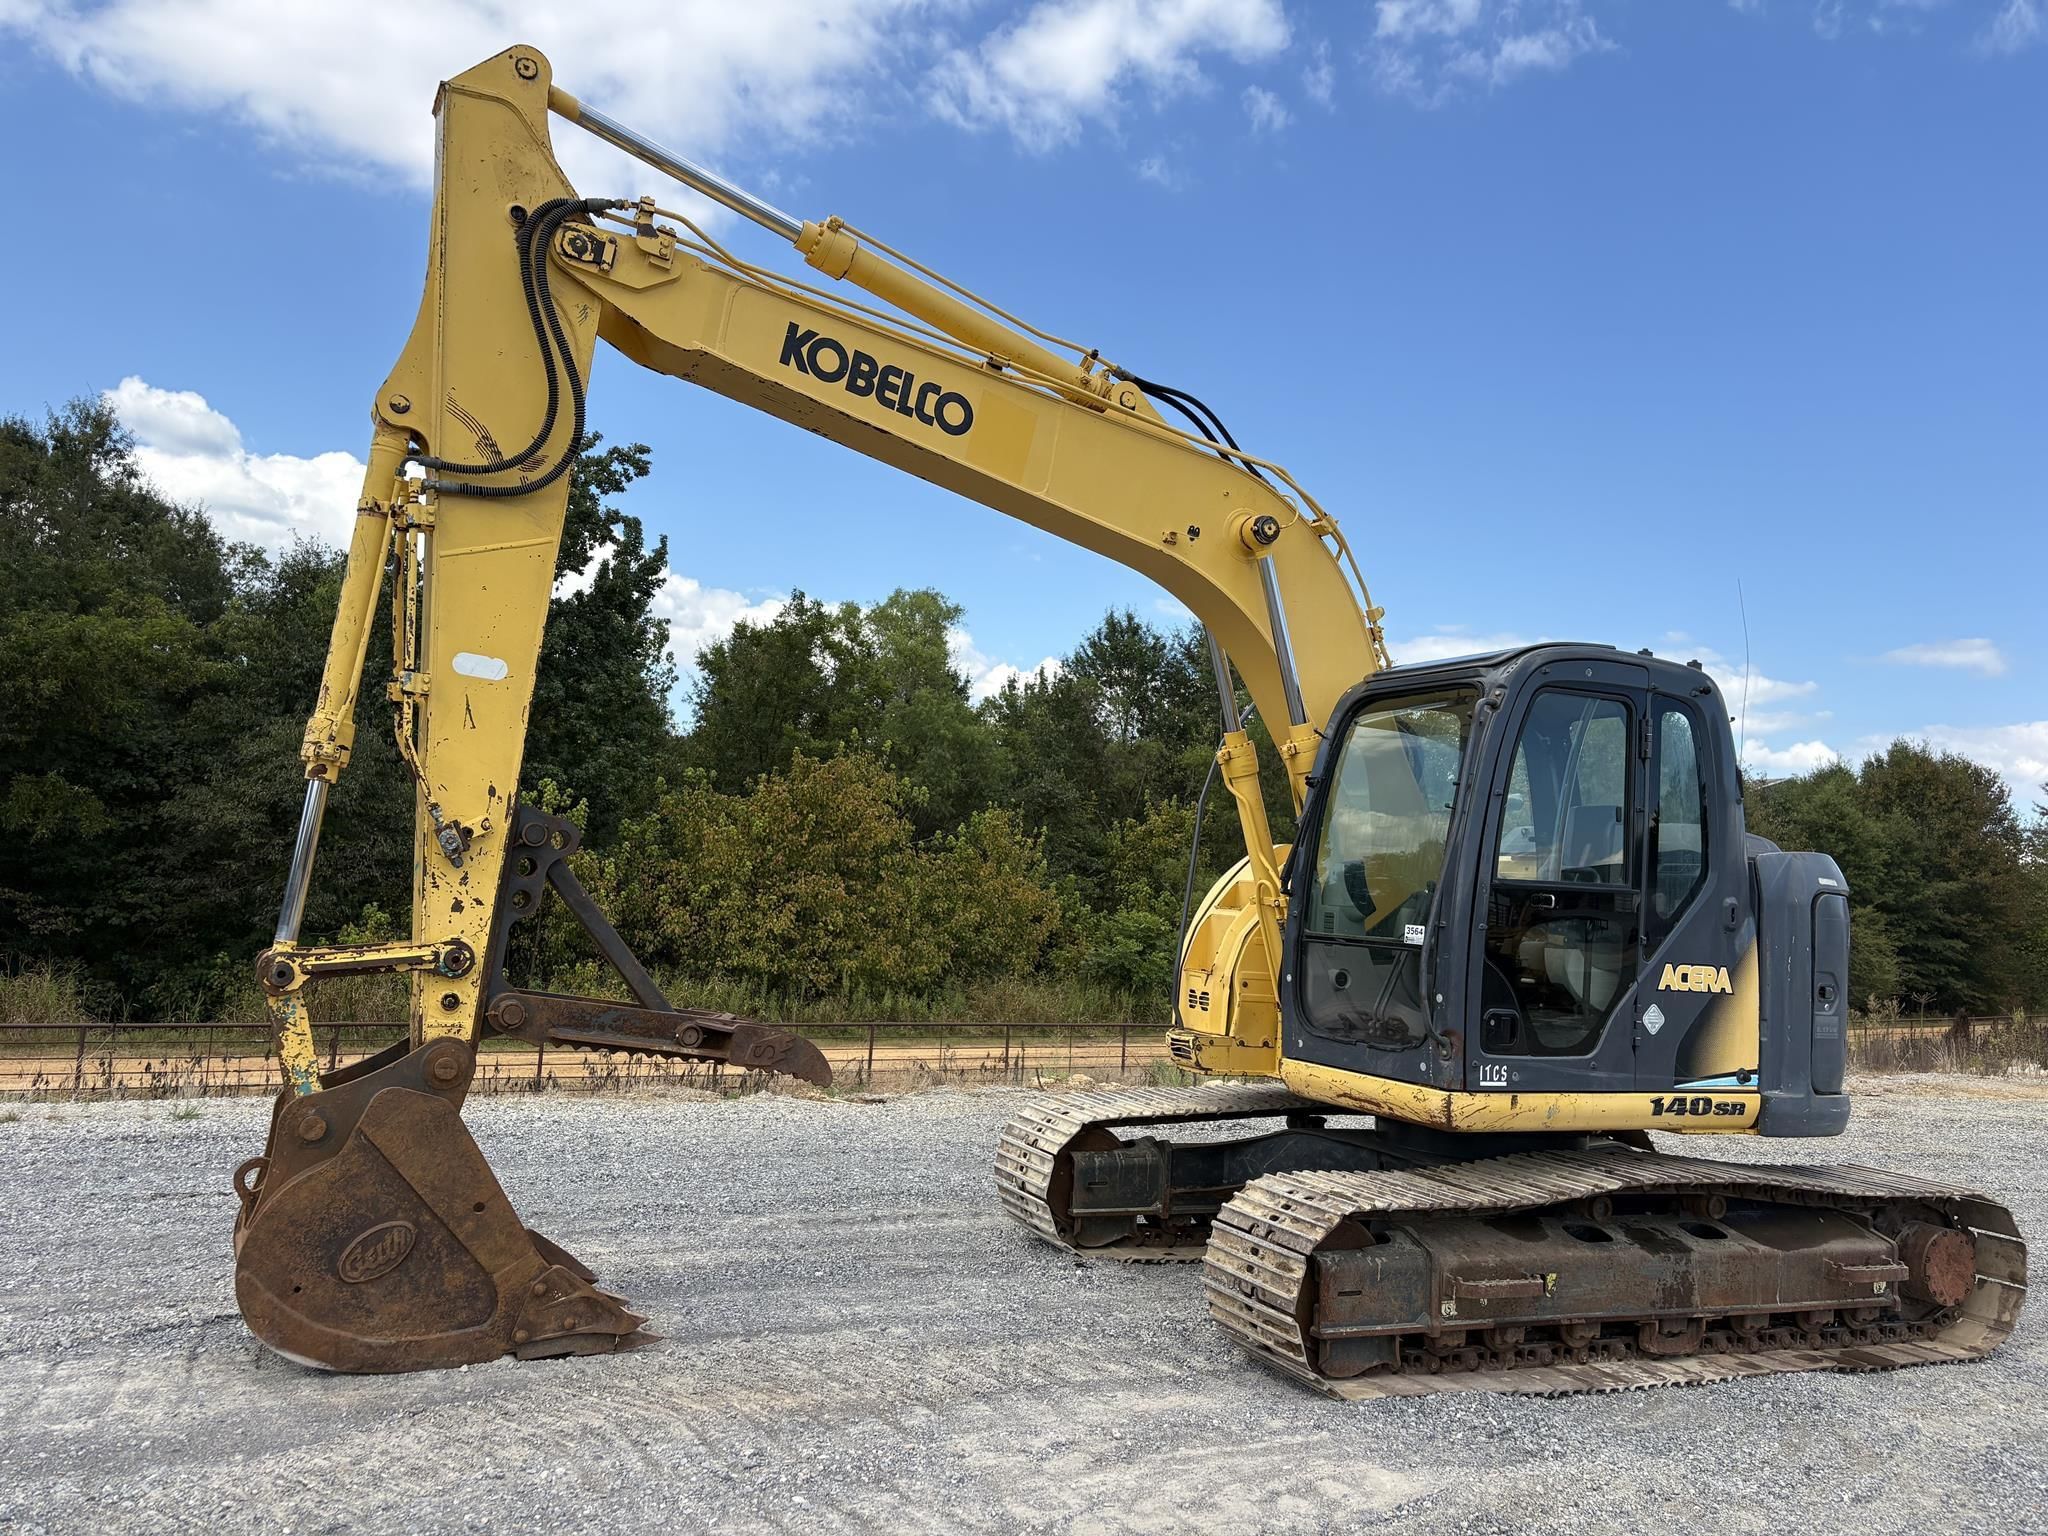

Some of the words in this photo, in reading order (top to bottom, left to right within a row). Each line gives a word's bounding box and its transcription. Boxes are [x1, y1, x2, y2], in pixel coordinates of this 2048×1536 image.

[779, 321, 974, 436] KOBELCO
[1406, 926, 1423, 935] 3564
[1657, 963, 1734, 994] ACERA
[1480, 1064, 1507, 1081] ITCS
